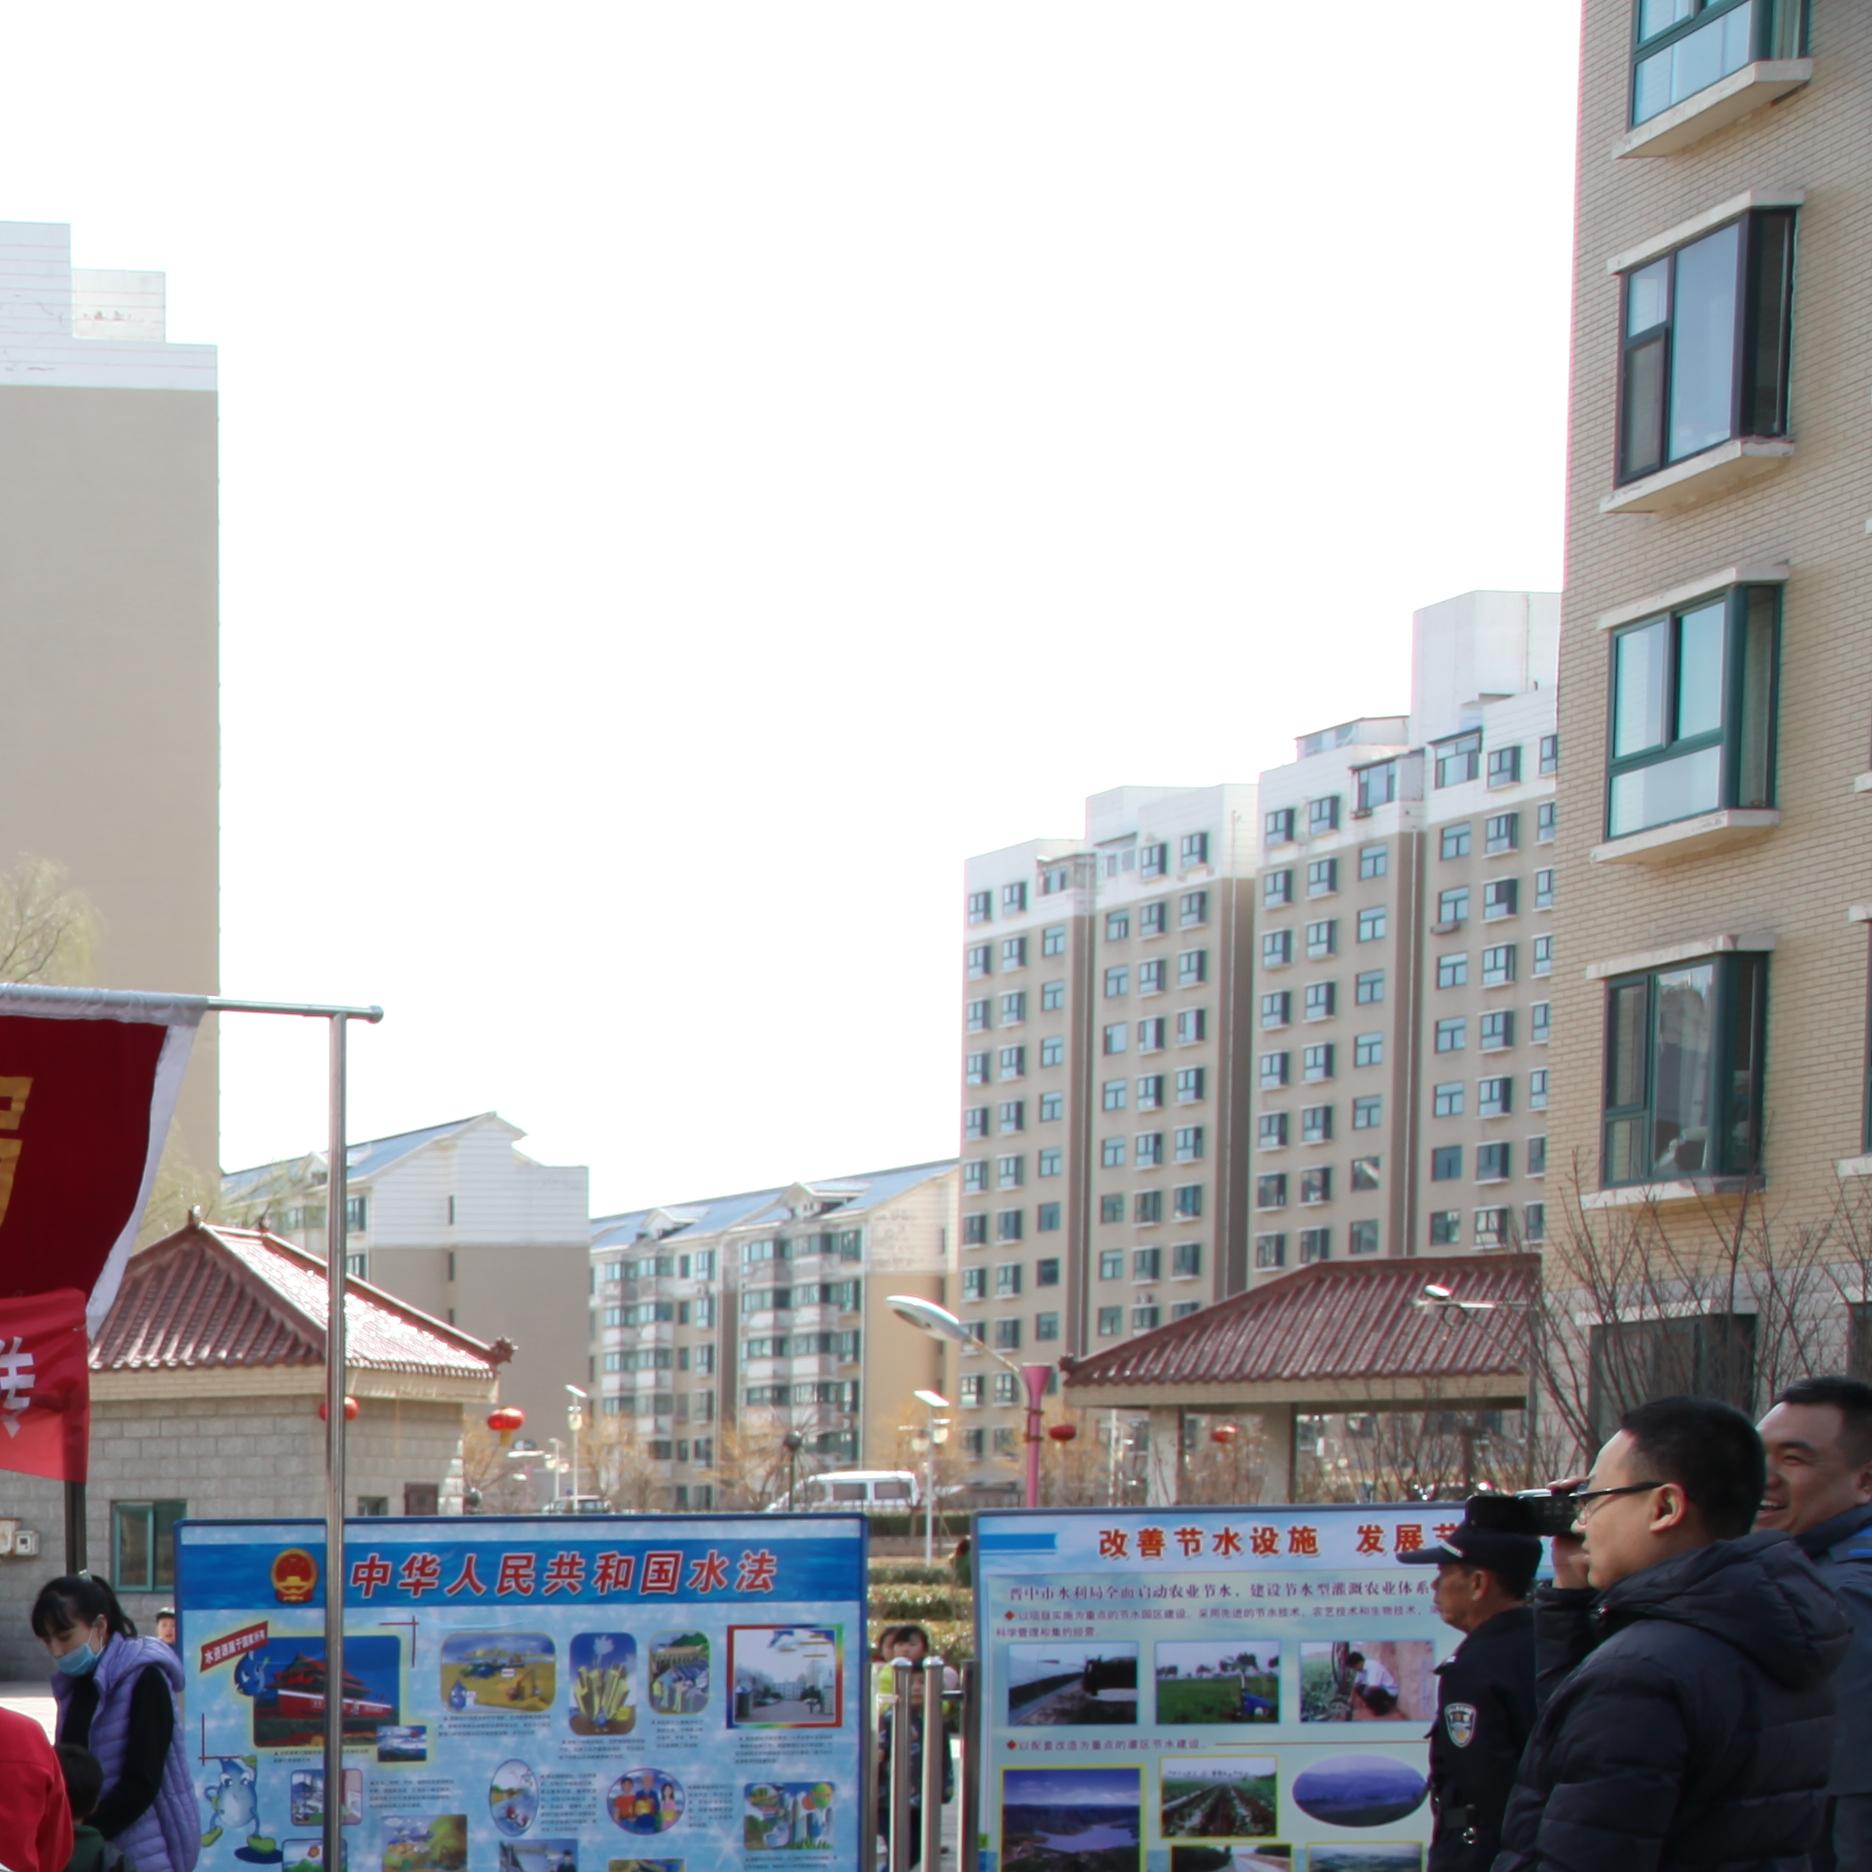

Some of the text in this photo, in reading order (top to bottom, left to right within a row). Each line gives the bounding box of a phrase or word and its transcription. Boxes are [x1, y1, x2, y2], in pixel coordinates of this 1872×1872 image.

[1098, 1526, 1320, 1557] 改善节水设施
[349, 1550, 777, 1598] 中华人民共和国水法
